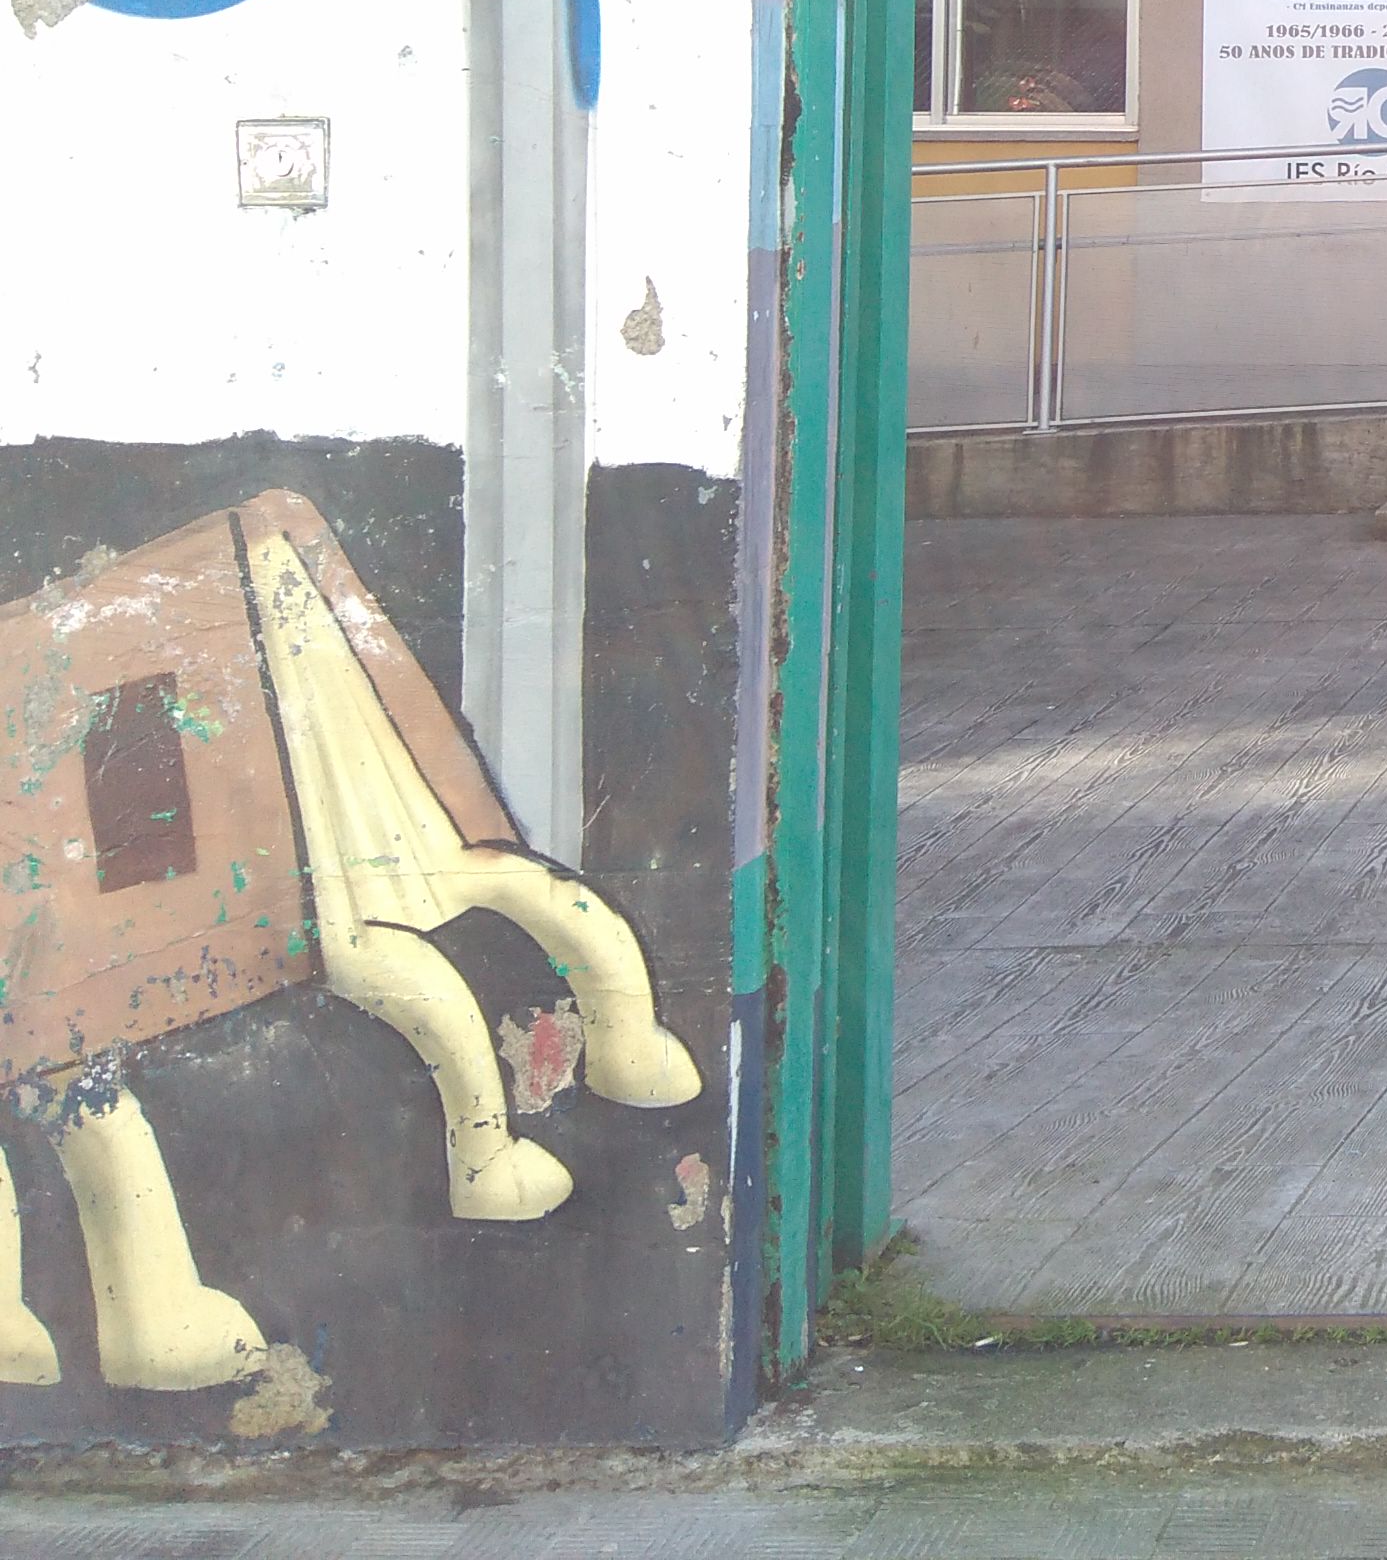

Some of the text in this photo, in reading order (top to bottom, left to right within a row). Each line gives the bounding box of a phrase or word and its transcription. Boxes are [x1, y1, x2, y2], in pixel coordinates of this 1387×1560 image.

[1309, 2, 1364, 11] Ensinanzas
[1265, 24, 1364, 39] 1965/1966
[1219, 45, 1243, 59] 50
[1248, 45, 1295, 59] ANOS
[1302, 45, 1325, 59] DE
